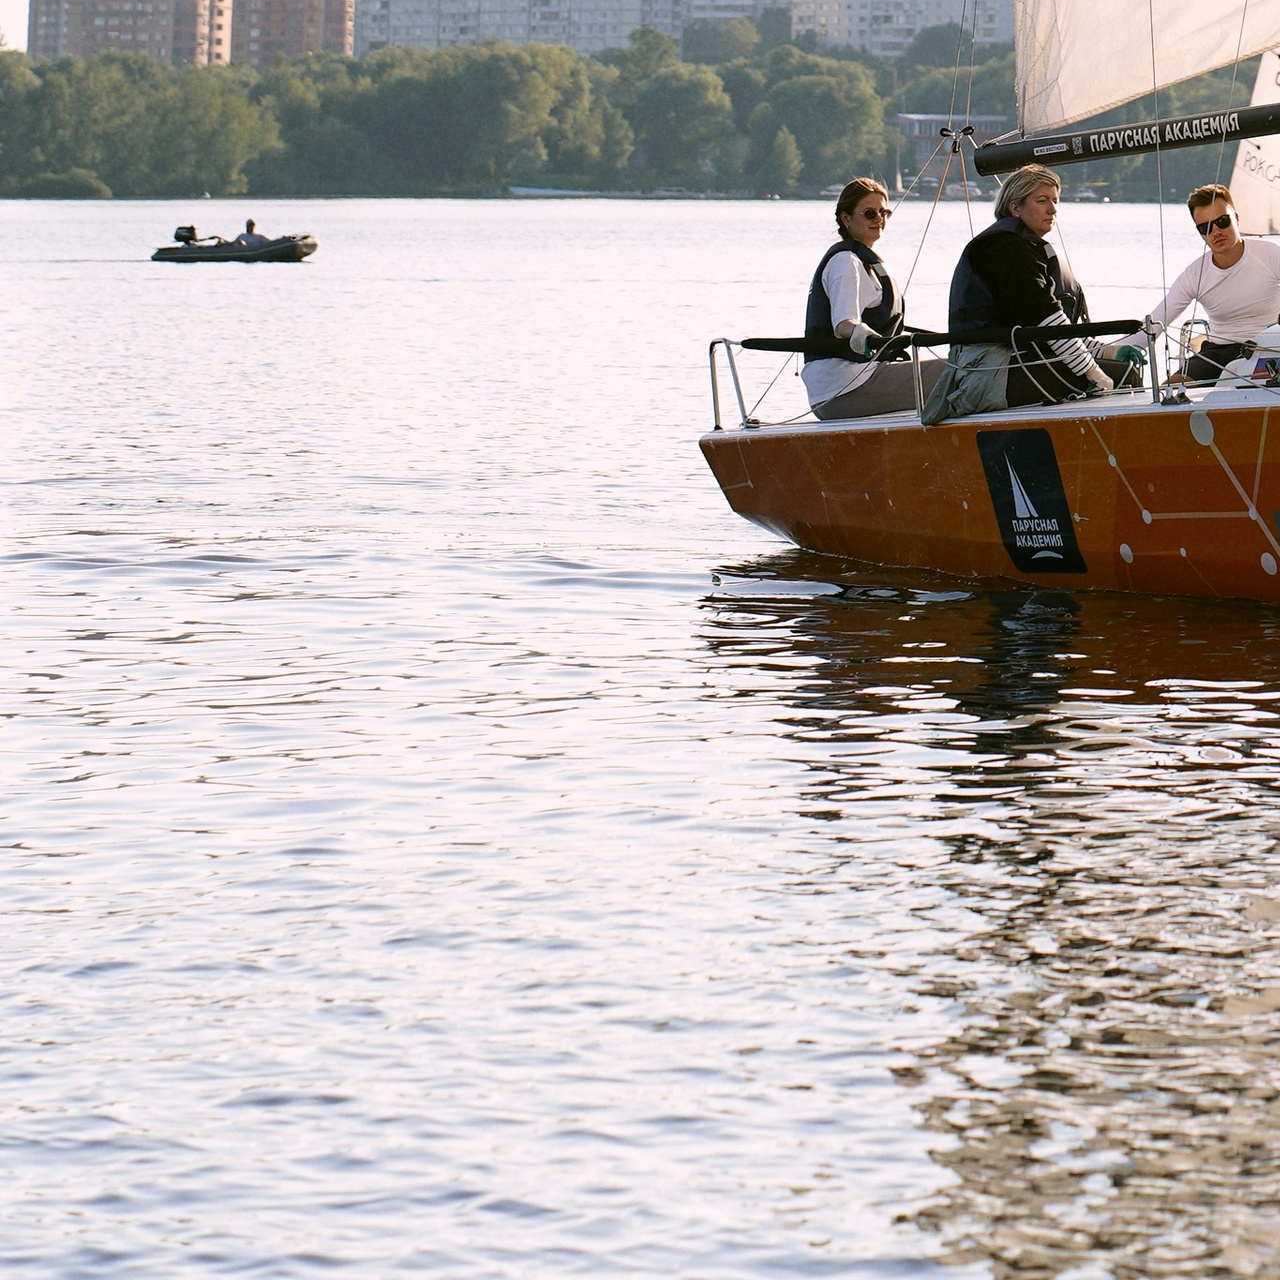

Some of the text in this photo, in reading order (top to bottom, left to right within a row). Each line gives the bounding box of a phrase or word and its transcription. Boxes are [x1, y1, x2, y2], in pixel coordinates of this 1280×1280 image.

[1089, 112, 1240, 153] ПАРУСНАЯ АКАДЕМИЯ
[1012, 519, 1059, 532] ПАРУСНАЯ
[1016, 534, 1063, 548] АКАДЕМИЯ
